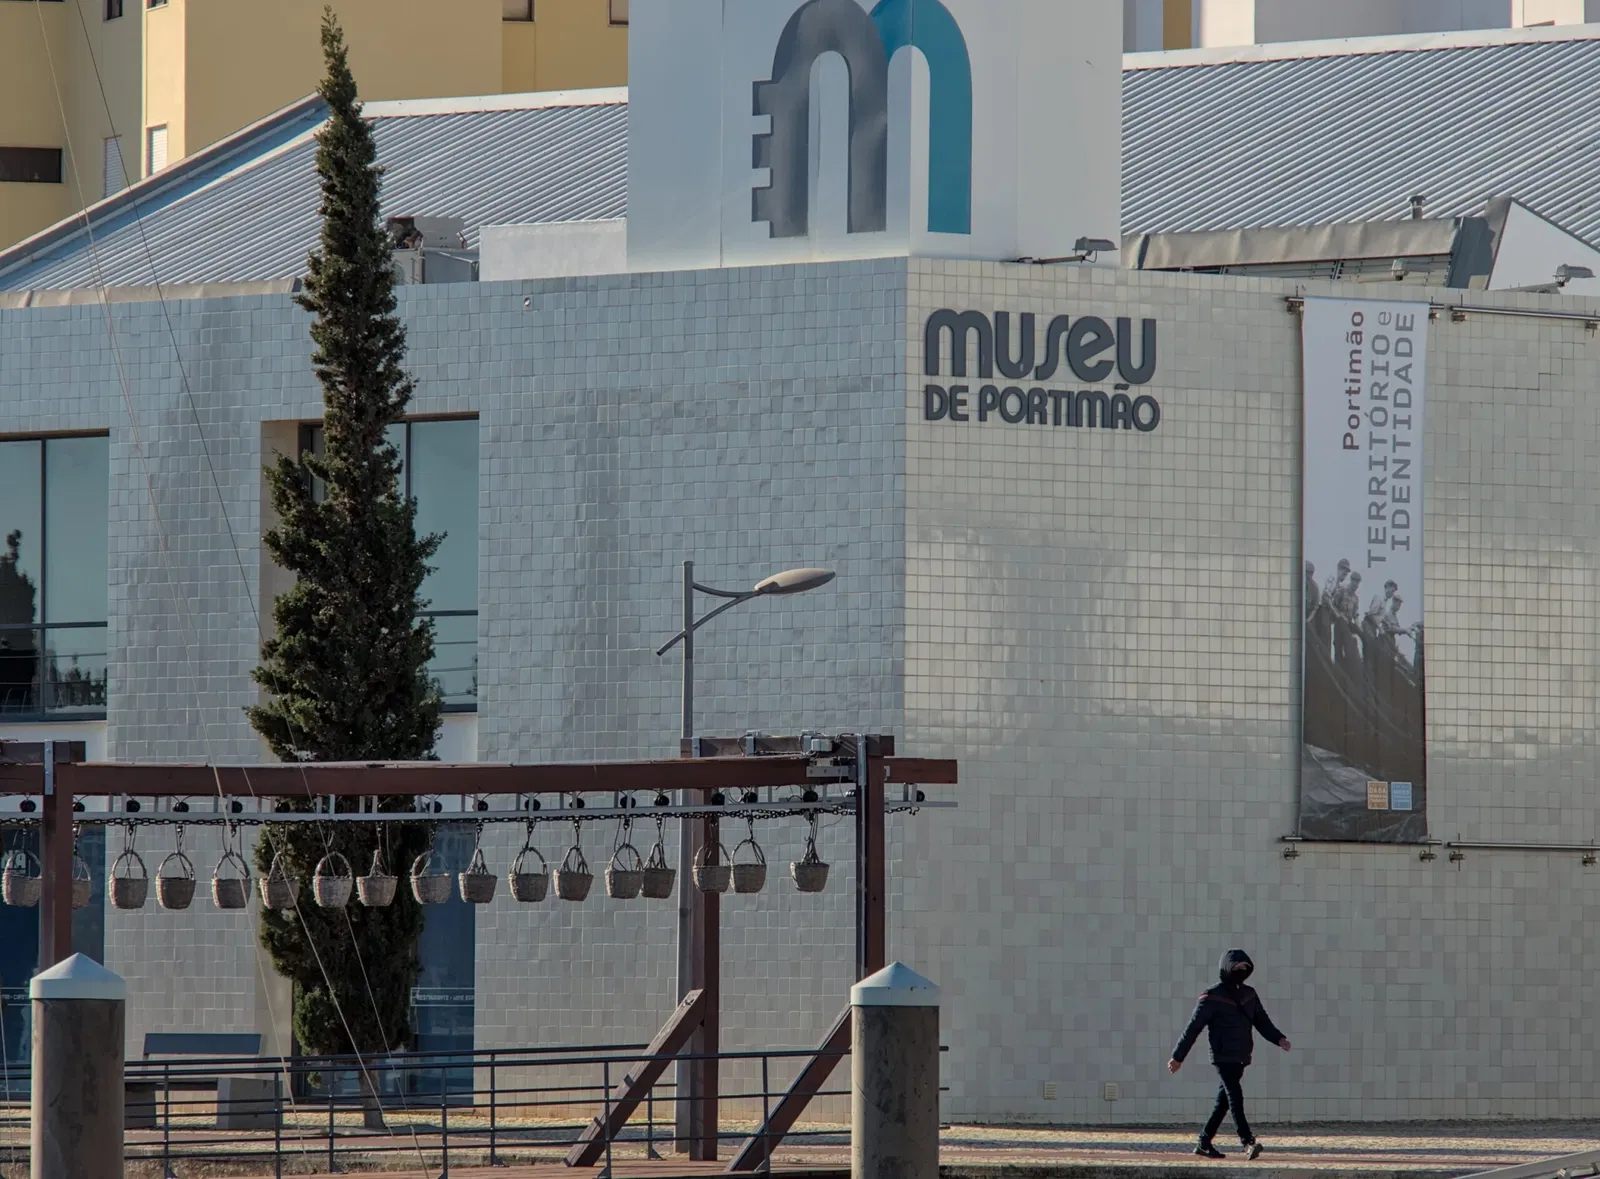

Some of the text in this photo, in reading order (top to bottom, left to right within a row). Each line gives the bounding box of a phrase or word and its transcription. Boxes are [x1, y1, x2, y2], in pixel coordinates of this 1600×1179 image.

[925, 383, 1161, 432] DE PORTIMÃO
[1342, 311, 1364, 450] Portimão
[1365, 311, 1392, 568] TERRITÓRIO e
[1391, 313, 1415, 551] IDENTIDADE
